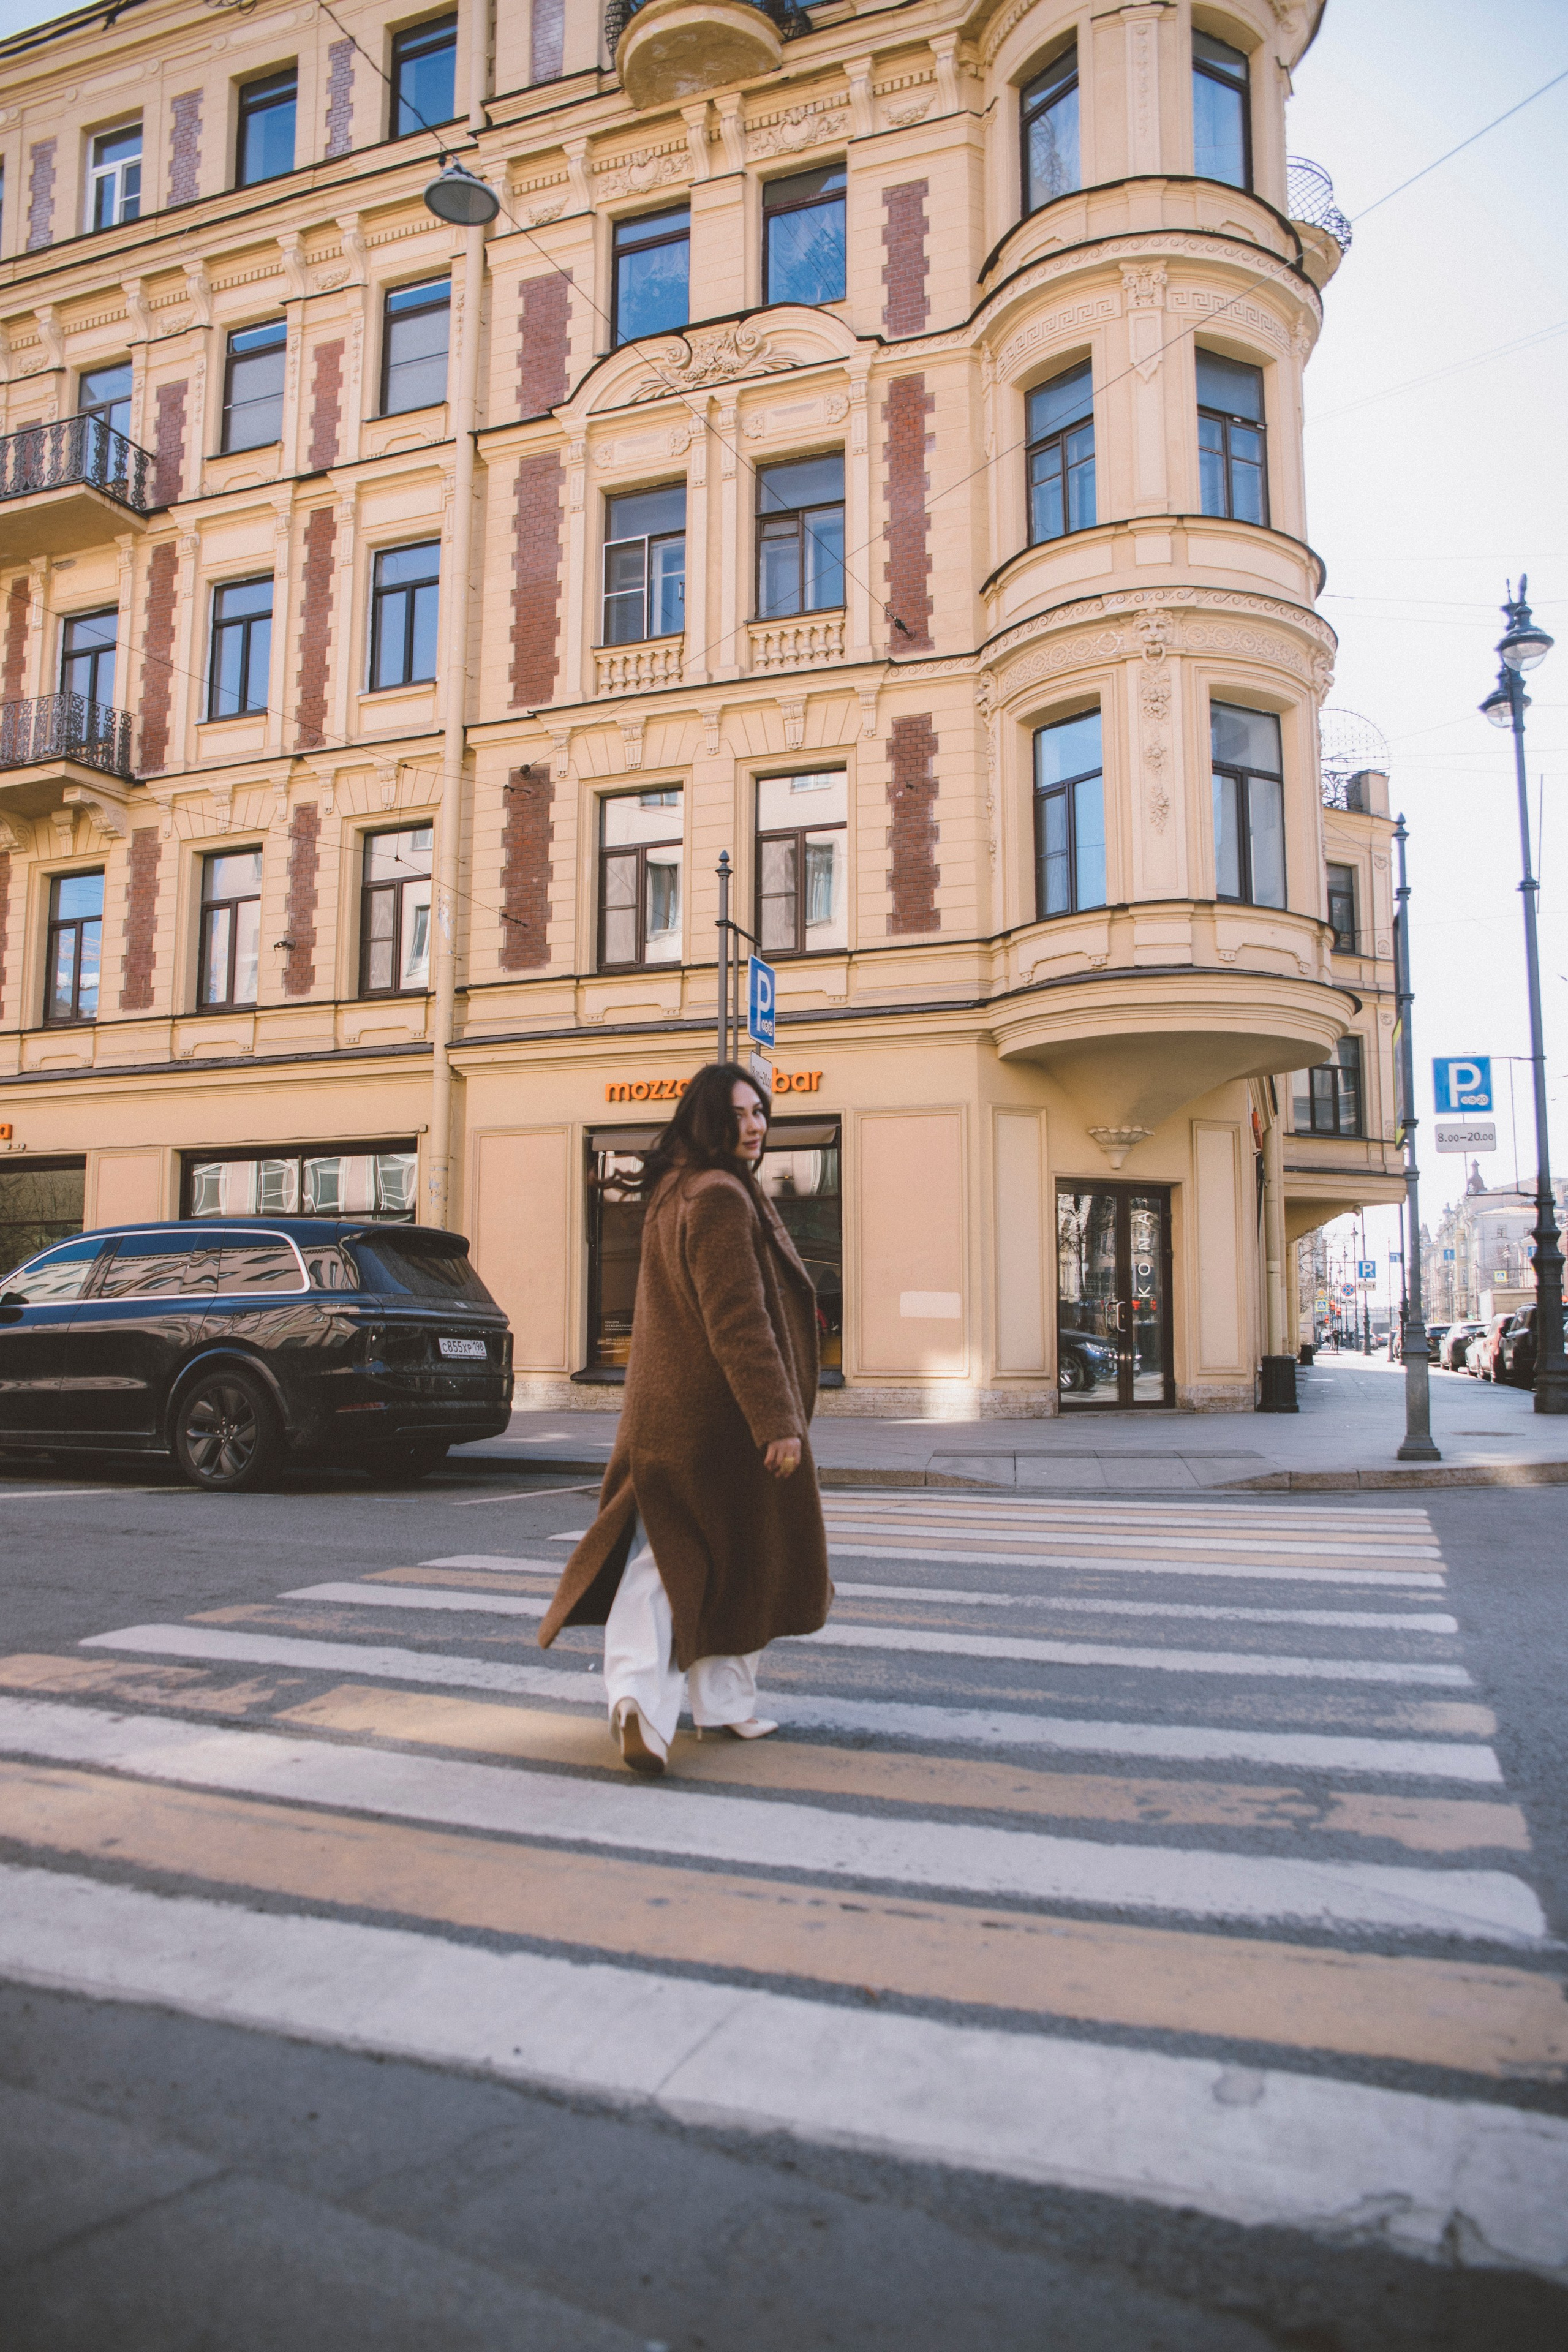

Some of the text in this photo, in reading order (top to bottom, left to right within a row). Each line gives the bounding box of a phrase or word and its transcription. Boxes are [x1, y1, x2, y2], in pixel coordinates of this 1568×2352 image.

[756, 968, 771, 1031] P
[772, 1067, 823, 1092] bar
[1448, 1063, 1482, 1107] P
[1137, 1212, 1150, 1297] KONA
[1362, 1262, 1373, 1276] P
[473, 1341, 484, 1351] 198
